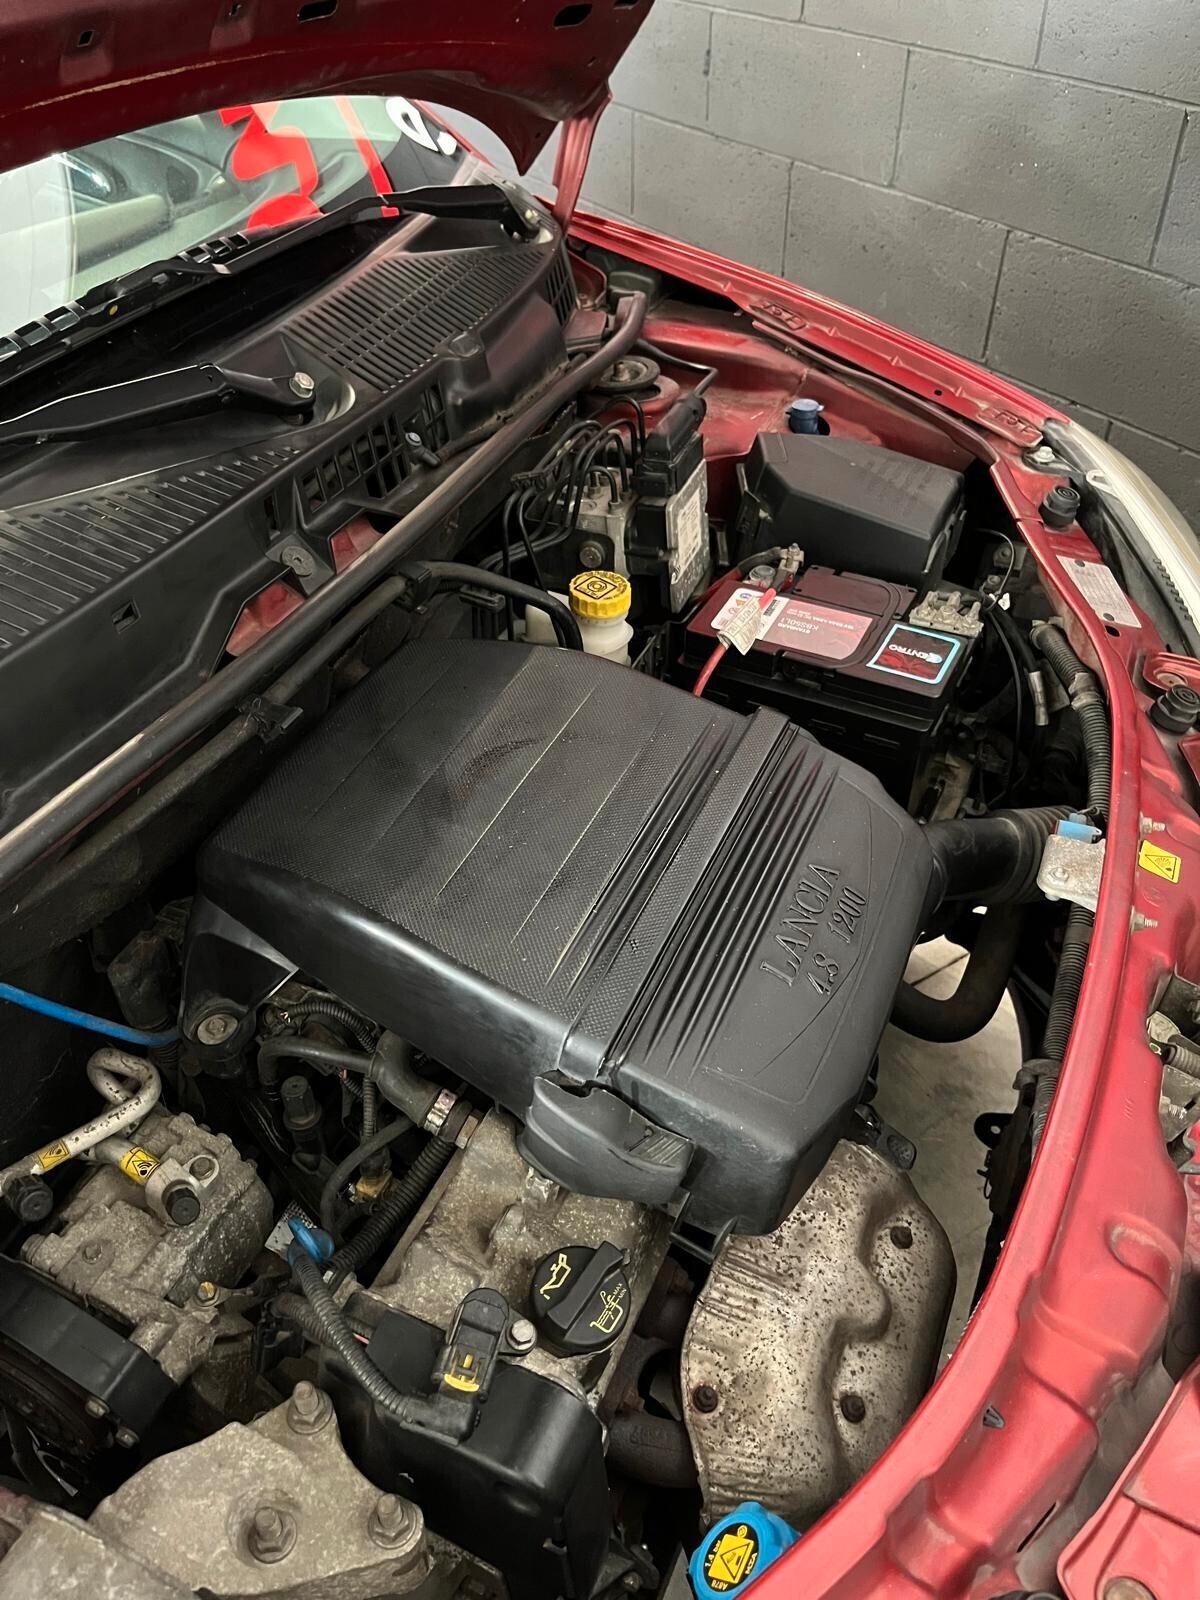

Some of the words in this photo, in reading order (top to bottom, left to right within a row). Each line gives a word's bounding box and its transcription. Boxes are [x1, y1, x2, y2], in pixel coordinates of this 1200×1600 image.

[760, 864, 841, 988] LANCIA
[827, 885, 867, 943] 1200
[612, 1283, 622, 1295] MAX
[704, 1554, 715, 1567] 1.4
